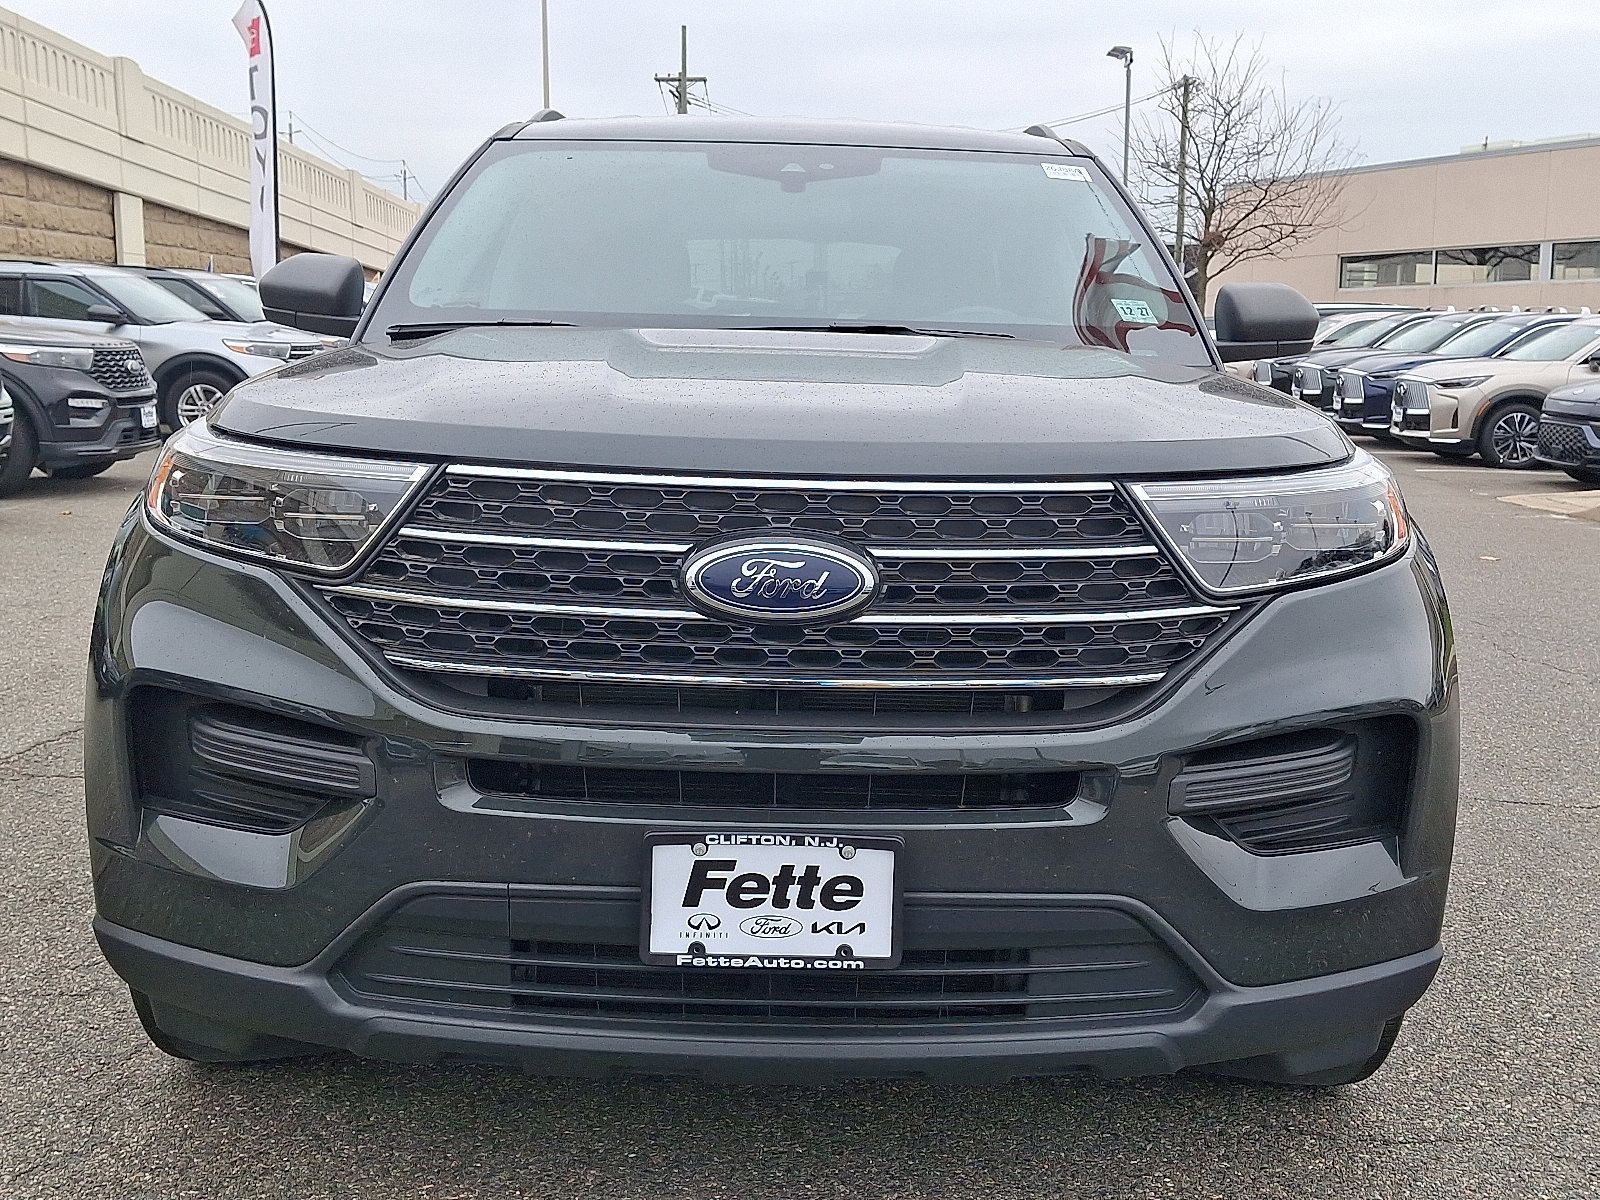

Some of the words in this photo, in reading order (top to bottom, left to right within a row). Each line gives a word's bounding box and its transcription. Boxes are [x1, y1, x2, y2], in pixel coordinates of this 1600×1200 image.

[1120, 306, 1135, 316] 12
[1137, 307, 1150, 317] 27
[731, 558, 830, 600] Ford
[705, 834, 796, 847] CLIFTON,
[804, 836, 844, 848] N.J.
[681, 859, 864, 911] Fette
[750, 917, 792, 936] Ford
[811, 921, 866, 935] KIA
[676, 954, 865, 969] FetteAuto.com
